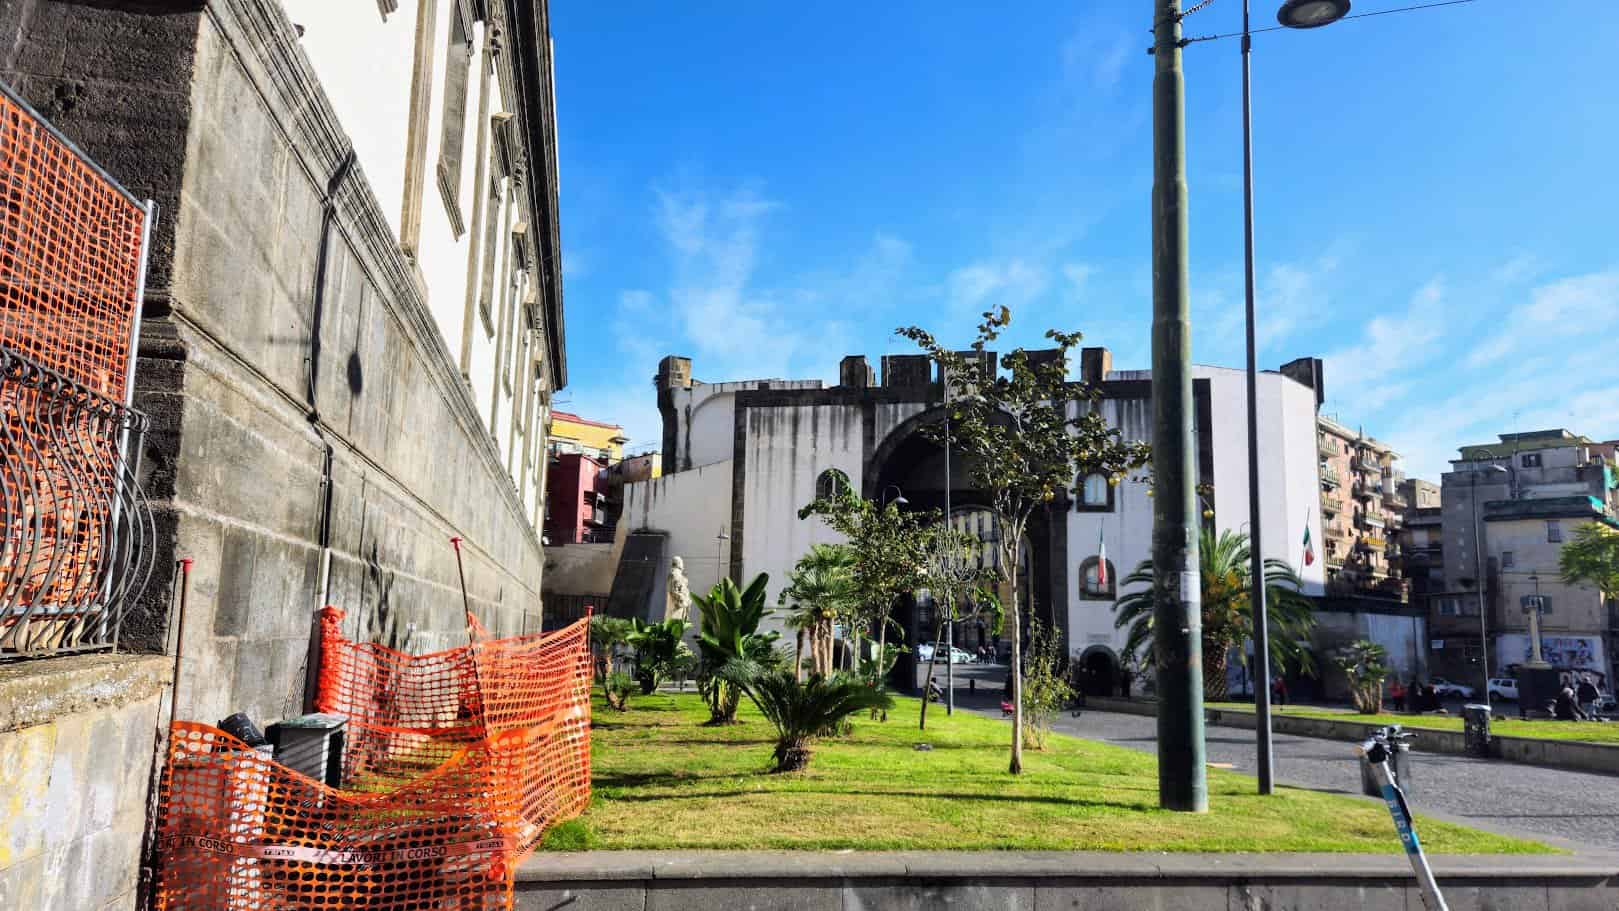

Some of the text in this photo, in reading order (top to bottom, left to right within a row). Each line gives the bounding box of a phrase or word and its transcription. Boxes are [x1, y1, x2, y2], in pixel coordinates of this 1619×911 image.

[199, 838, 234, 854] CORSO
[342, 846, 448, 863] LAVORI IN CORSO
